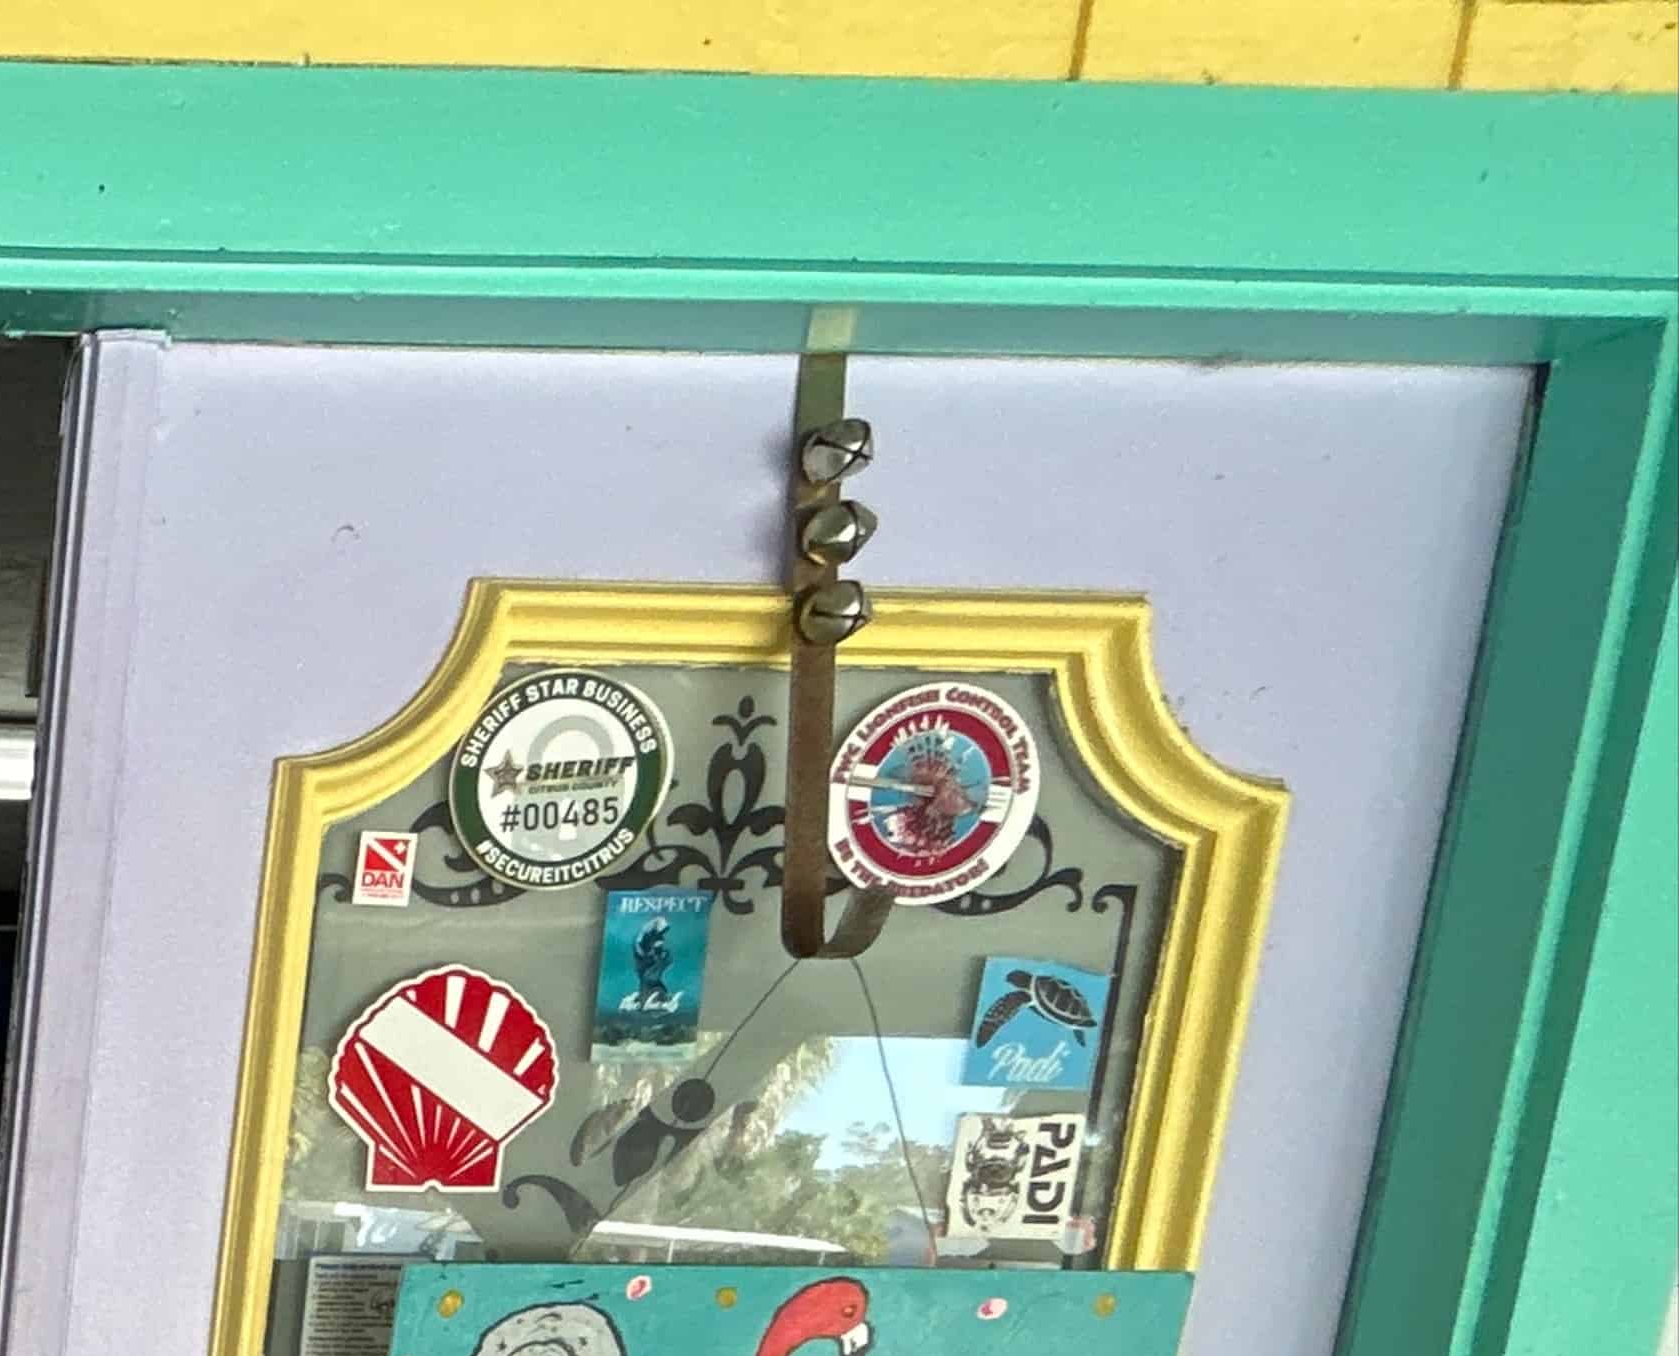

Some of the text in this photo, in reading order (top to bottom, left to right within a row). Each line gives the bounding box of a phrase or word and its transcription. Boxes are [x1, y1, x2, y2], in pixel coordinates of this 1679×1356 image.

[460, 678, 658, 768] SHERIFF STAR BUSINESS
[525, 756, 636, 782] SHERIFF
[501, 797, 619, 833] #00485
[476, 827, 635, 885] #SECUREITCITRUS
[361, 872, 405, 889] DAN
[618, 896, 708, 913] RESPECT
[987, 1040, 1071, 1083] Padi
[1022, 1122, 1077, 1225] PADI
